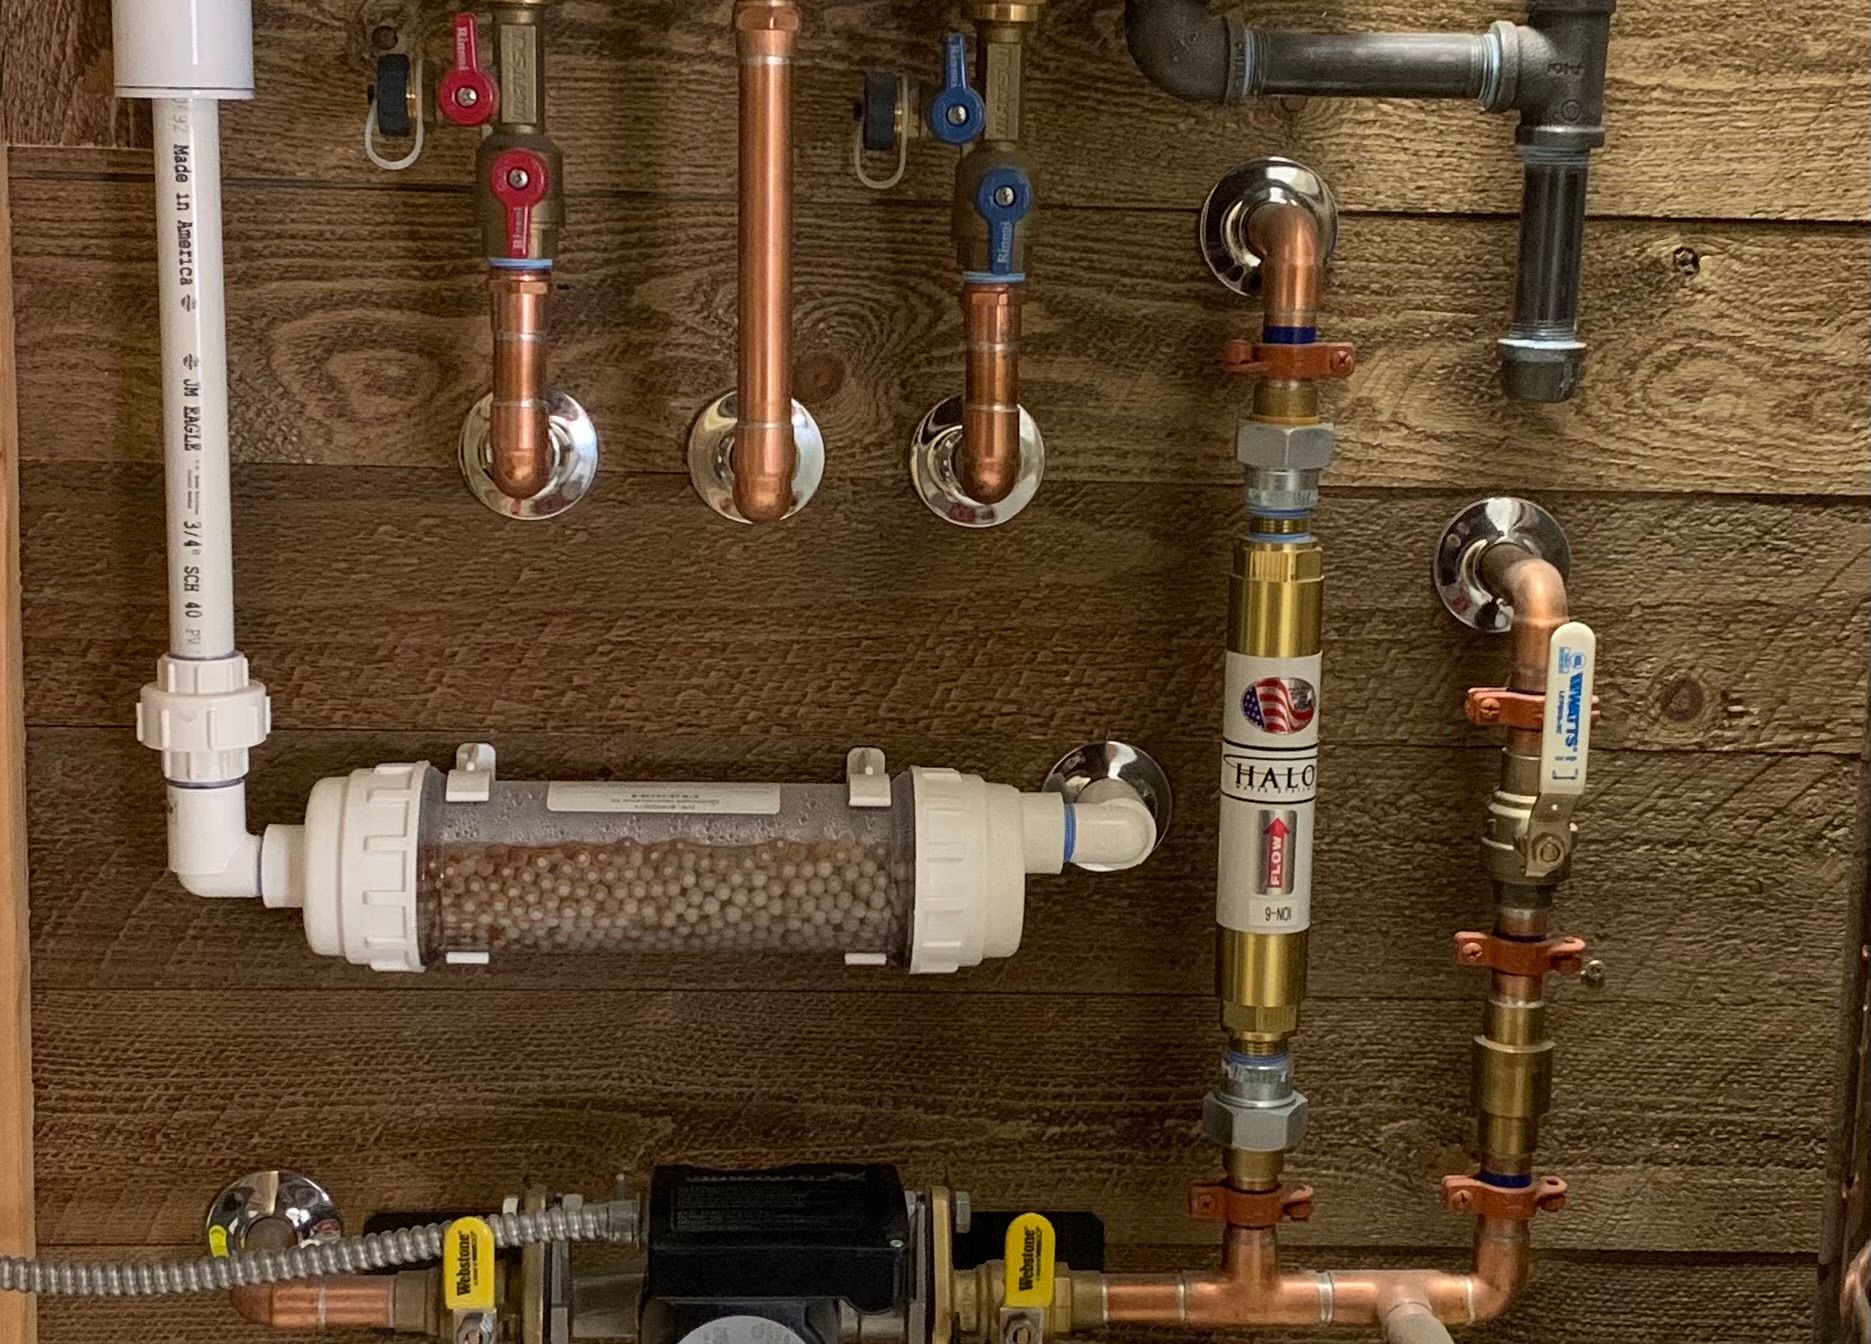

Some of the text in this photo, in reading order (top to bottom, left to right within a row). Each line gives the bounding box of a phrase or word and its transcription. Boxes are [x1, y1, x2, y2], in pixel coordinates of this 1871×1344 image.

[173, 143, 189, 184] Made
[176, 192, 190, 212] in
[177, 220, 193, 286] America
[184, 378, 200, 397] JM
[184, 405, 202, 452] EAGLE
[184, 565, 200, 592] SCH
[184, 601, 202, 619] 40
[1564, 672, 1584, 747] WATTS
[1236, 763, 1315, 788] HALO
[1270, 836, 1282, 886] FLOW
[456, 1232, 471, 1297] Webstone
[1018, 1229, 1035, 1293] Webstone
